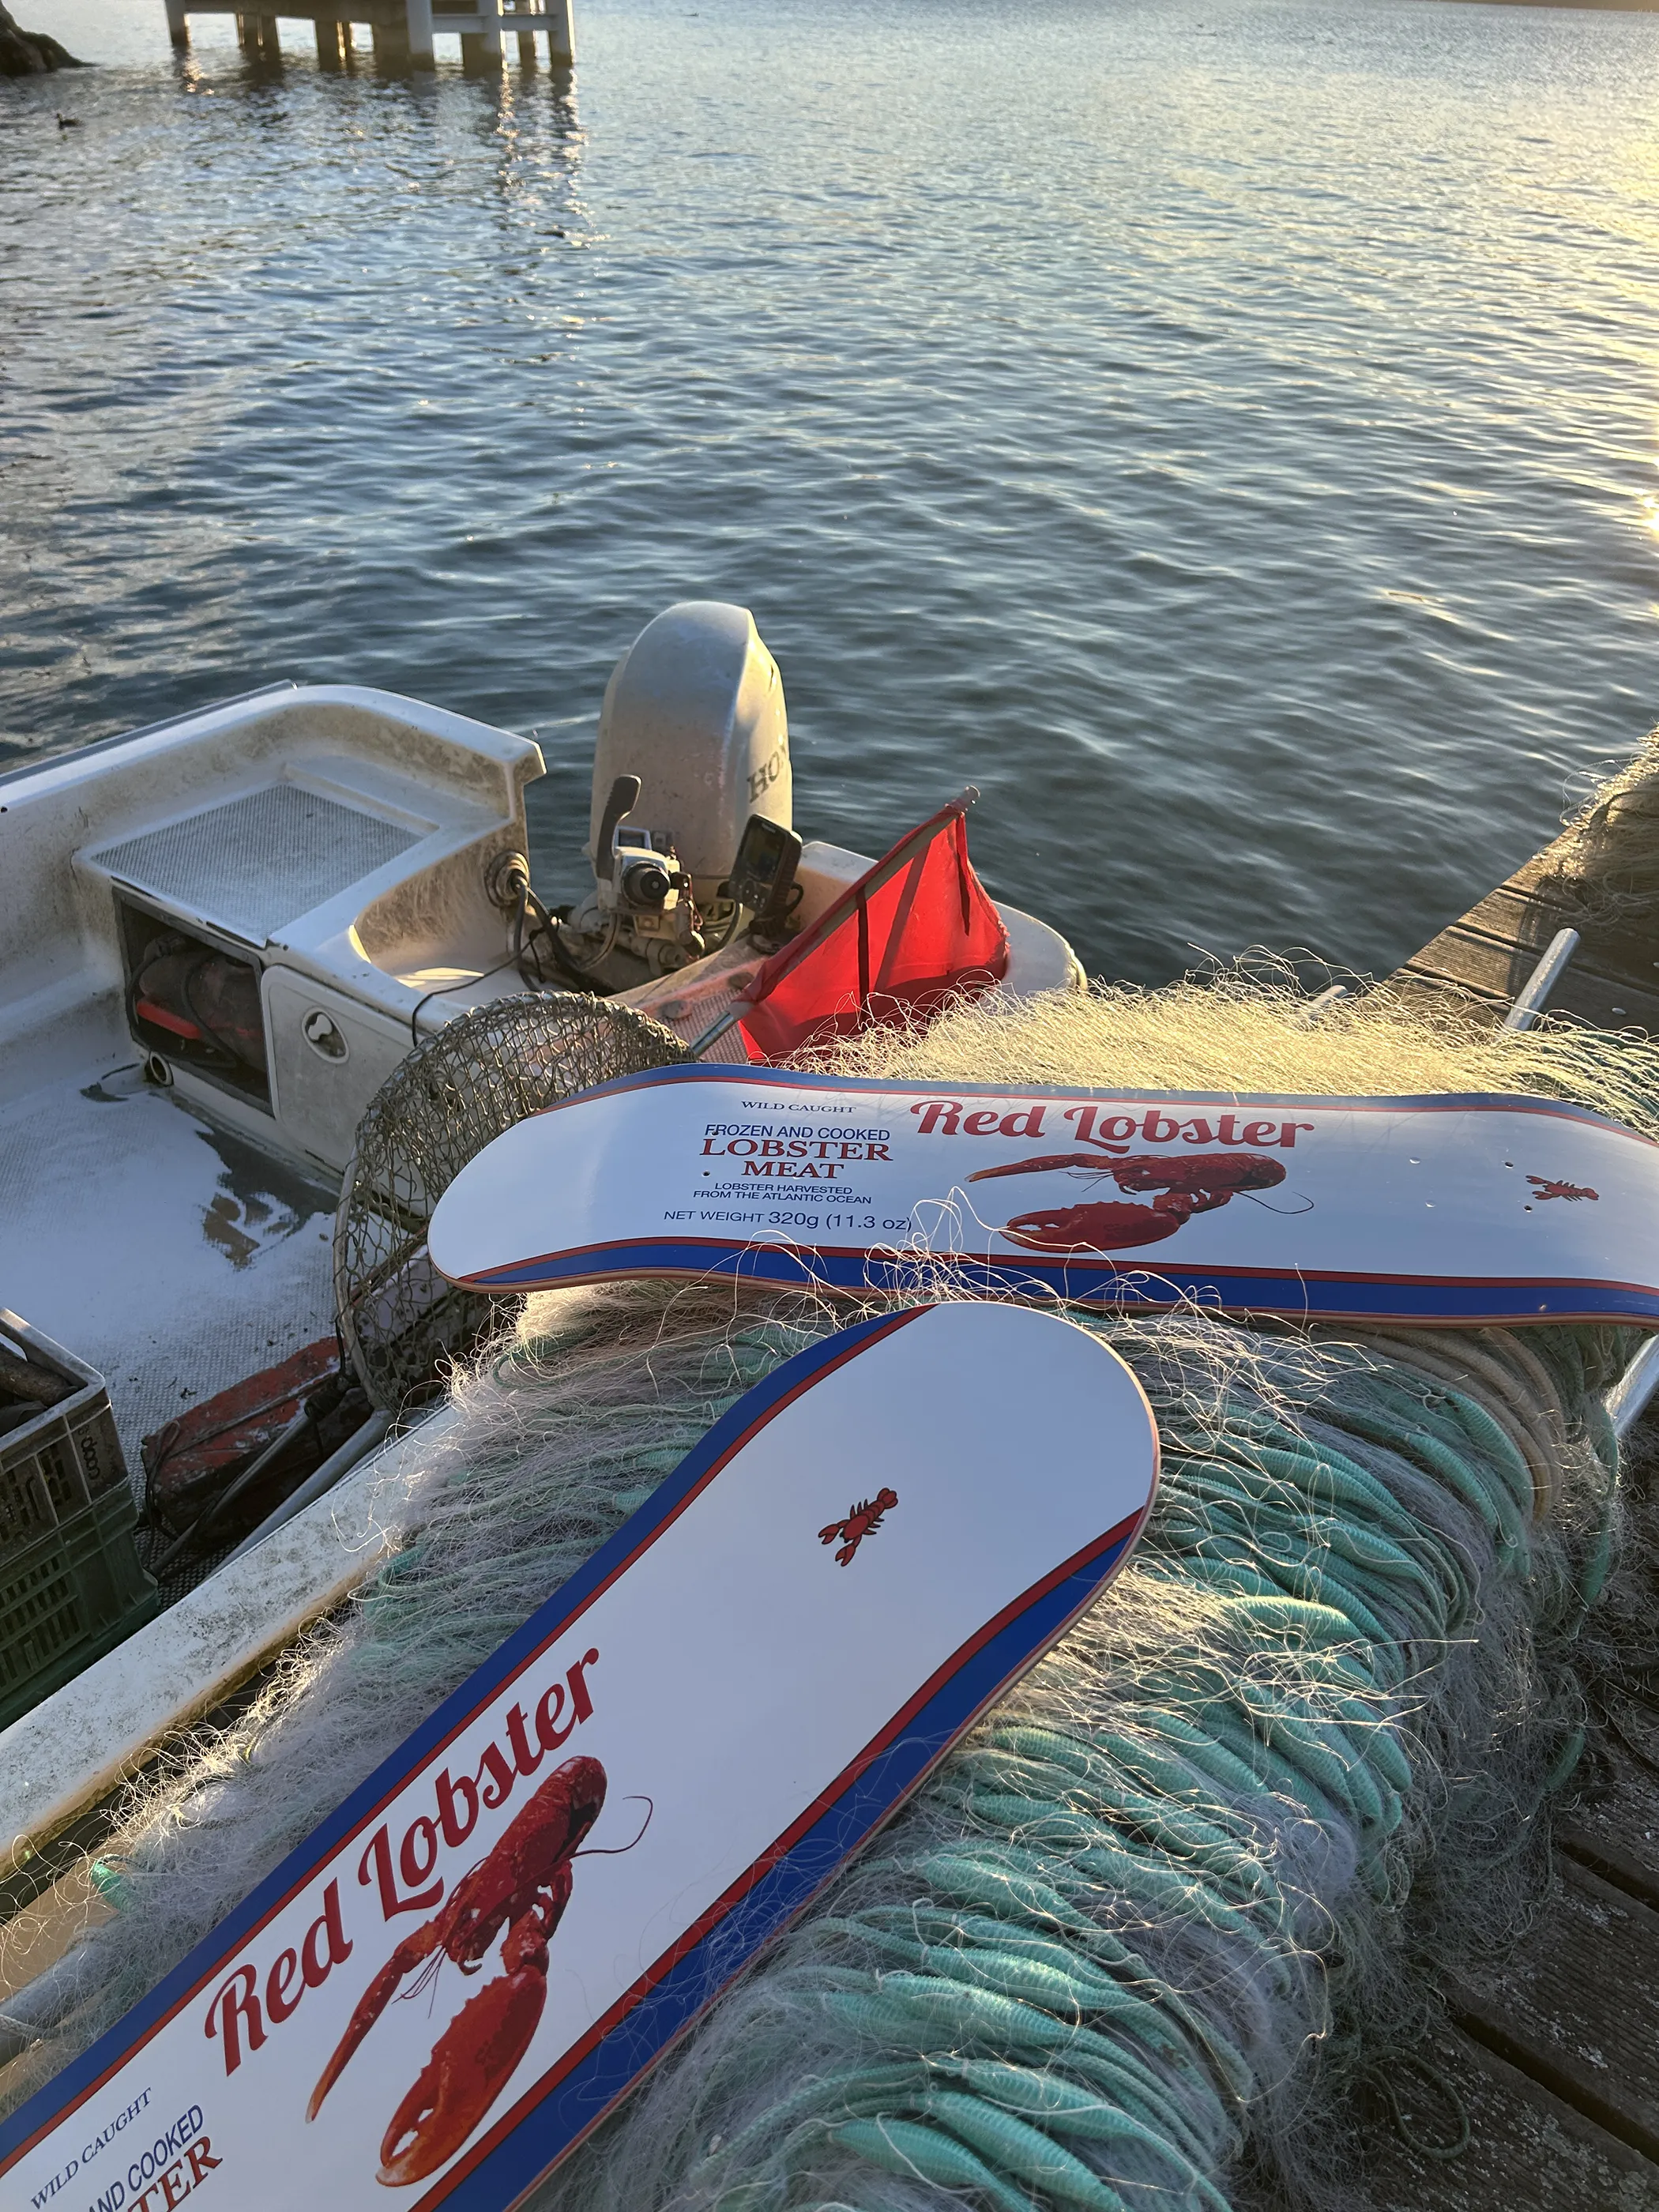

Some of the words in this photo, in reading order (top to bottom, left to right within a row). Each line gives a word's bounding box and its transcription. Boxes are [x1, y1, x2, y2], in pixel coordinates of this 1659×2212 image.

[747, 744, 787, 803] HO
[741, 1100, 784, 1110] WILD
[788, 1104, 856, 1114] CAUGHT
[704, 1124, 773, 1138] FROZEN
[776, 1125, 814, 1138] AND
[817, 1127, 890, 1142] COOKED
[910, 1100, 1047, 1138] Red
[1063, 1106, 1315, 1154] Lobster
[699, 1138, 893, 1161] LOBSTER
[741, 1161, 845, 1179] MEAT
[714, 1182, 774, 1191] LOBSTER
[777, 1184, 853, 1194] HARVESTED
[762, 1193, 824, 1202] ATLANTIC
[826, 1194, 872, 1204] OCEAN
[664, 1210, 697, 1221] NET
[700, 1211, 766, 1224] WEIGHT
[768, 1211, 819, 1229] 320g
[826, 1213, 876, 1230] (11.3
[882, 1217, 912, 1232] oz)
[204, 1877, 354, 2077] Red
[357, 1647, 600, 1922] Lobster
[30, 2159, 79, 2210] WILD
[81, 2087, 152, 2165] CAUGHT
[88, 2180, 126, 2212] ND
[127, 2104, 204, 2192] COOKED
